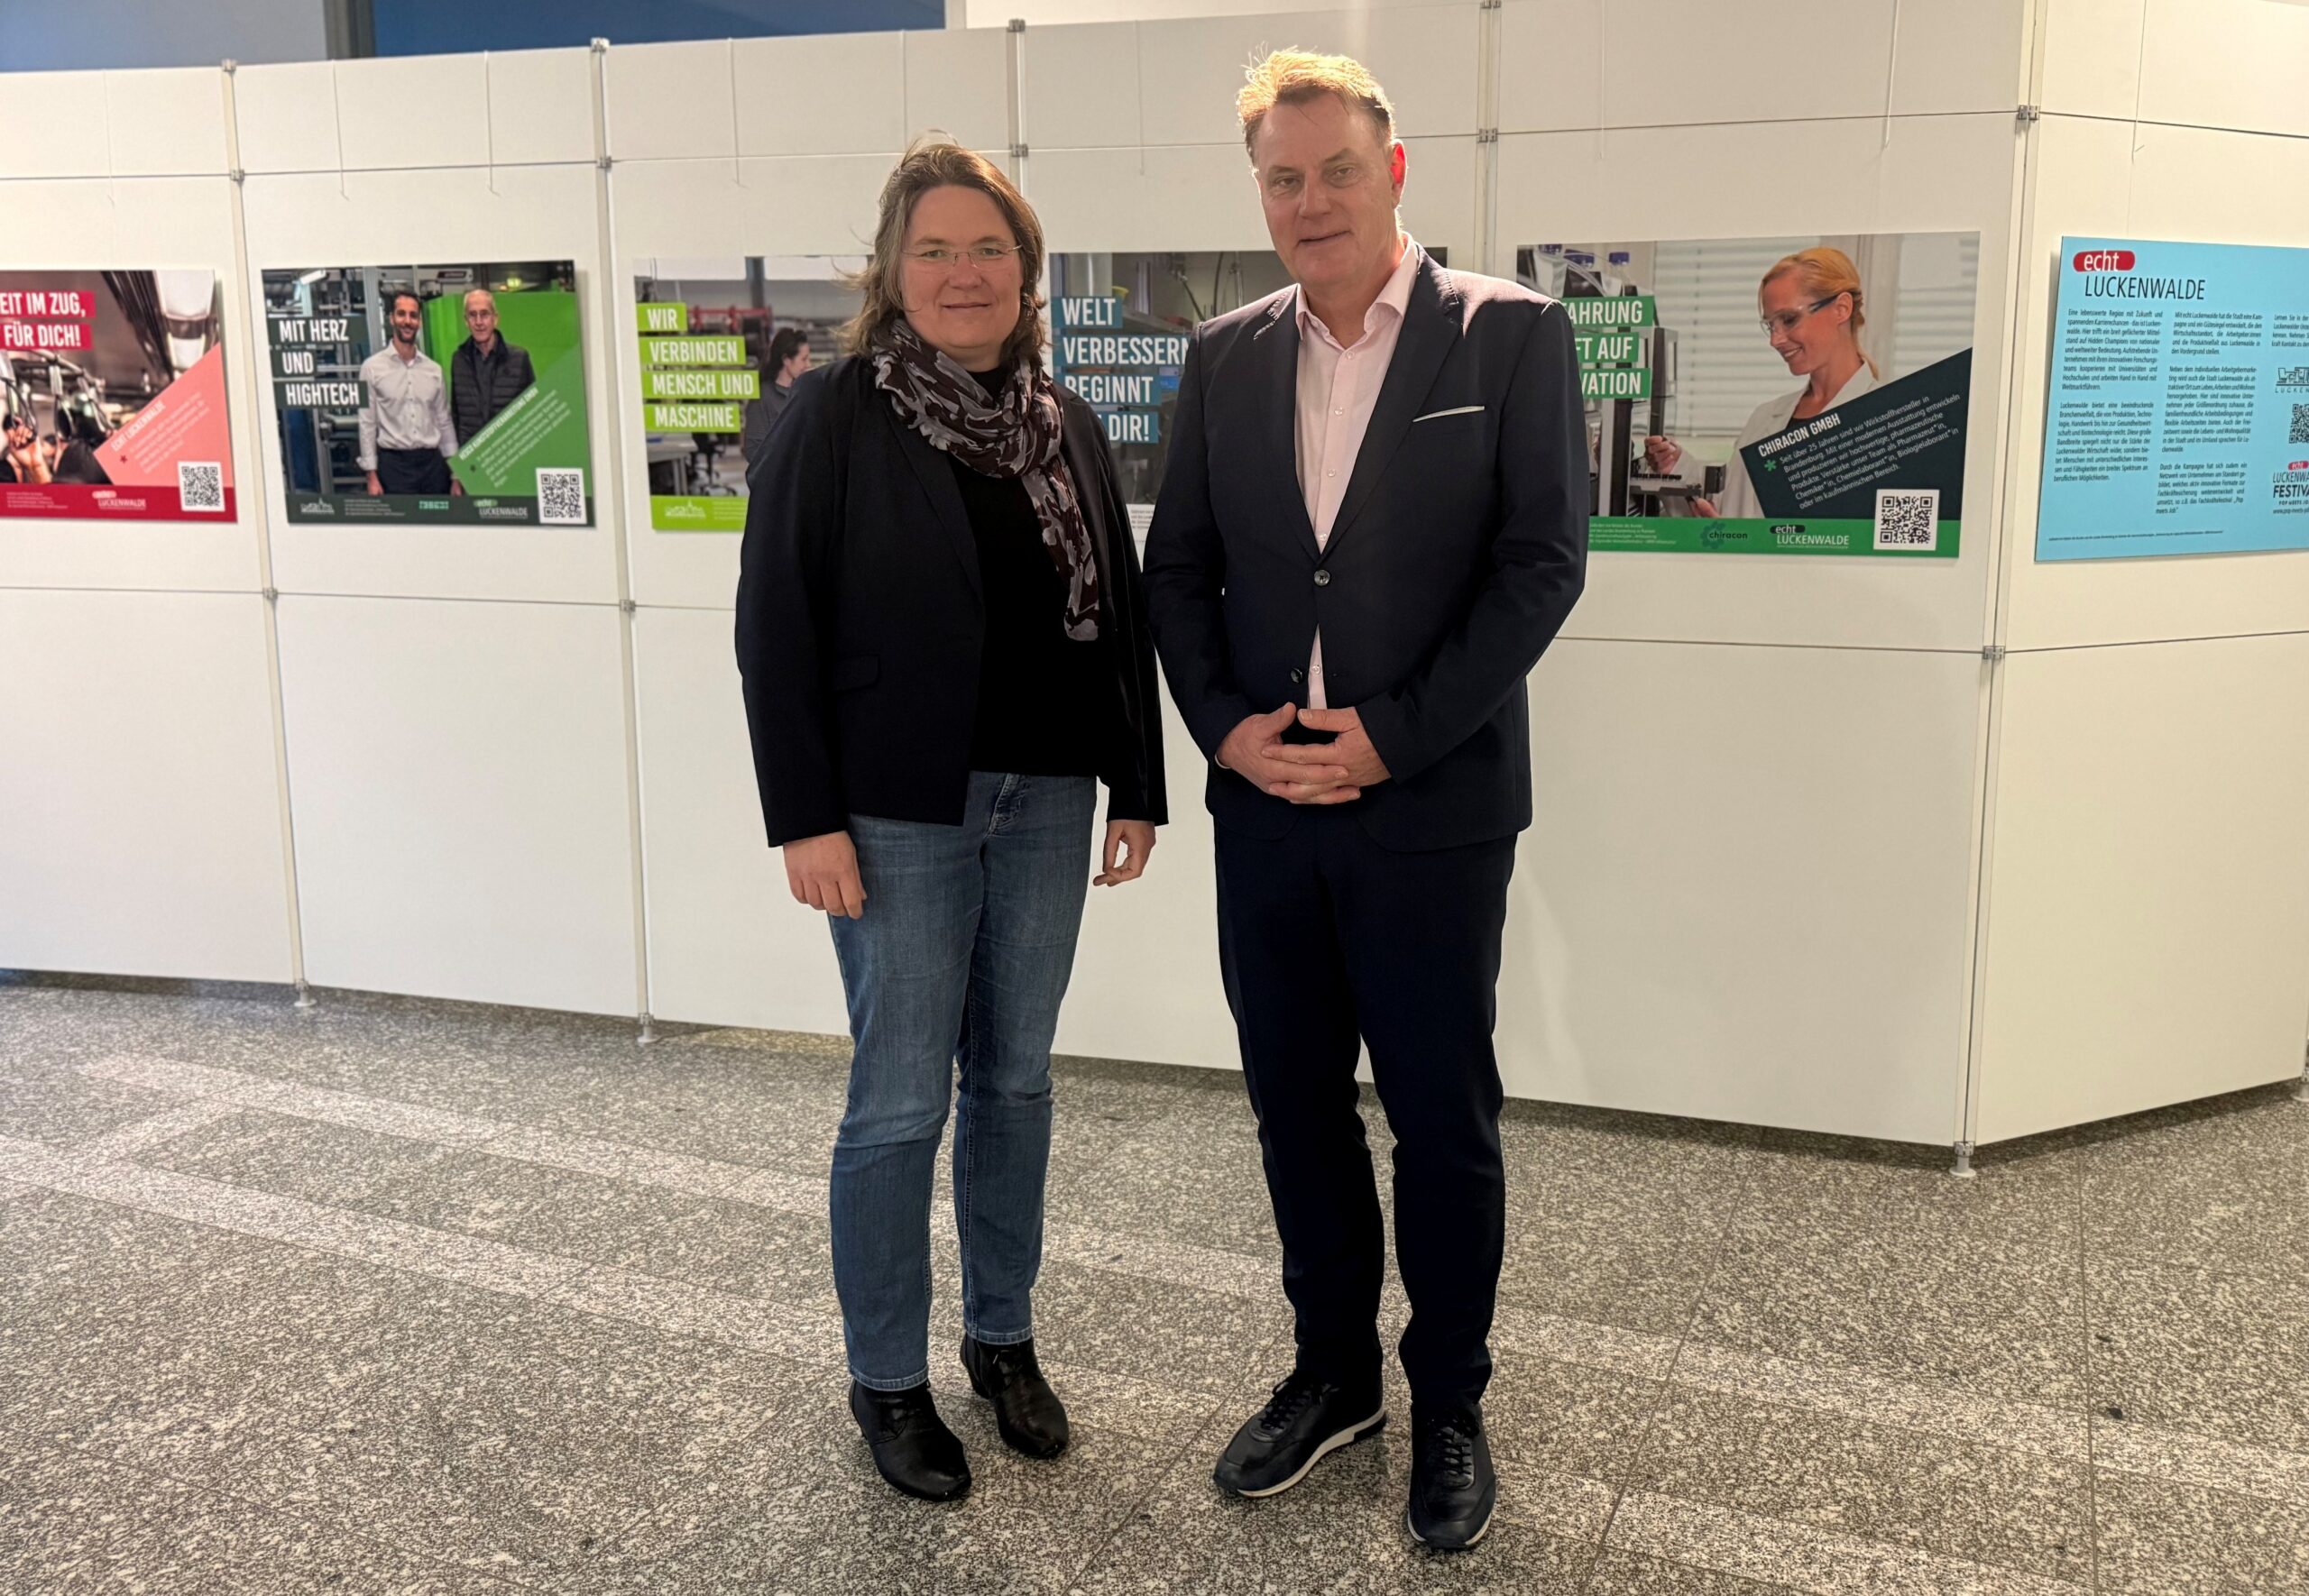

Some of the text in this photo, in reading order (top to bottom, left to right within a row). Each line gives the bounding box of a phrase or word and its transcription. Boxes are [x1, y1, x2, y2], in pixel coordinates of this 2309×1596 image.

[2084, 249, 2120, 271] echt
[2084, 275, 2205, 300] LUCKENWALDE
[26, 292, 47, 315] IM
[49, 292, 86, 318] ZUG,
[1062, 298, 1116, 326] WELT
[1563, 301, 1642, 325] AHRUNG
[2109, 309, 2124, 317] Region
[279, 319, 350, 343] MIT HERZ
[647, 308, 678, 330] WIR
[4, 321, 81, 347] FÜR DICH!
[2104, 337, 2129, 345] Champions
[649, 341, 737, 362] VERBINDEN
[1597, 337, 1633, 360] AUF
[282, 352, 314, 374] UND
[285, 382, 360, 406] HIGHTECH
[652, 373, 754, 395] MENSCH UND
[655, 406, 734, 427] MASCHINE
[1109, 414, 1149, 441] DIR!
[1758, 413, 1841, 457] CHIRACON GMBH
[1780, 453, 1792, 464] Seit
[1793, 448, 1808, 458] über
[1808, 444, 1817, 452] 25
[1818, 435, 1839, 447] Jahren
[1839, 427, 1854, 438] sind
[1854, 424, 1864, 433] wir
[1863, 399, 1921, 427] Wirkstoffhersteller
[1783, 394, 1961, 473] Brandenburg. Mit einer modernen Ausstattung entwickeln
[1788, 413, 1944, 482] und produzieren wir hochwertige, pharmazeutische
[1791, 475, 1821, 491] Produkte.
[1820, 463, 1850, 478] Verstärke
[1851, 455, 1868, 466] unser
[1868, 447, 1886, 459] Team
[1887, 443, 1897, 451] als
[1798, 498, 1814, 509] oder
[1814, 493, 1824, 502] im
[1823, 474, 1874, 500] kaufmännischen
[479, 507, 528, 516] LUCKENWALDE
[1709, 531, 1748, 540] chiracon
[1775, 524, 1796, 534] echt
[1777, 535, 1850, 545] LUCKENWALDE
